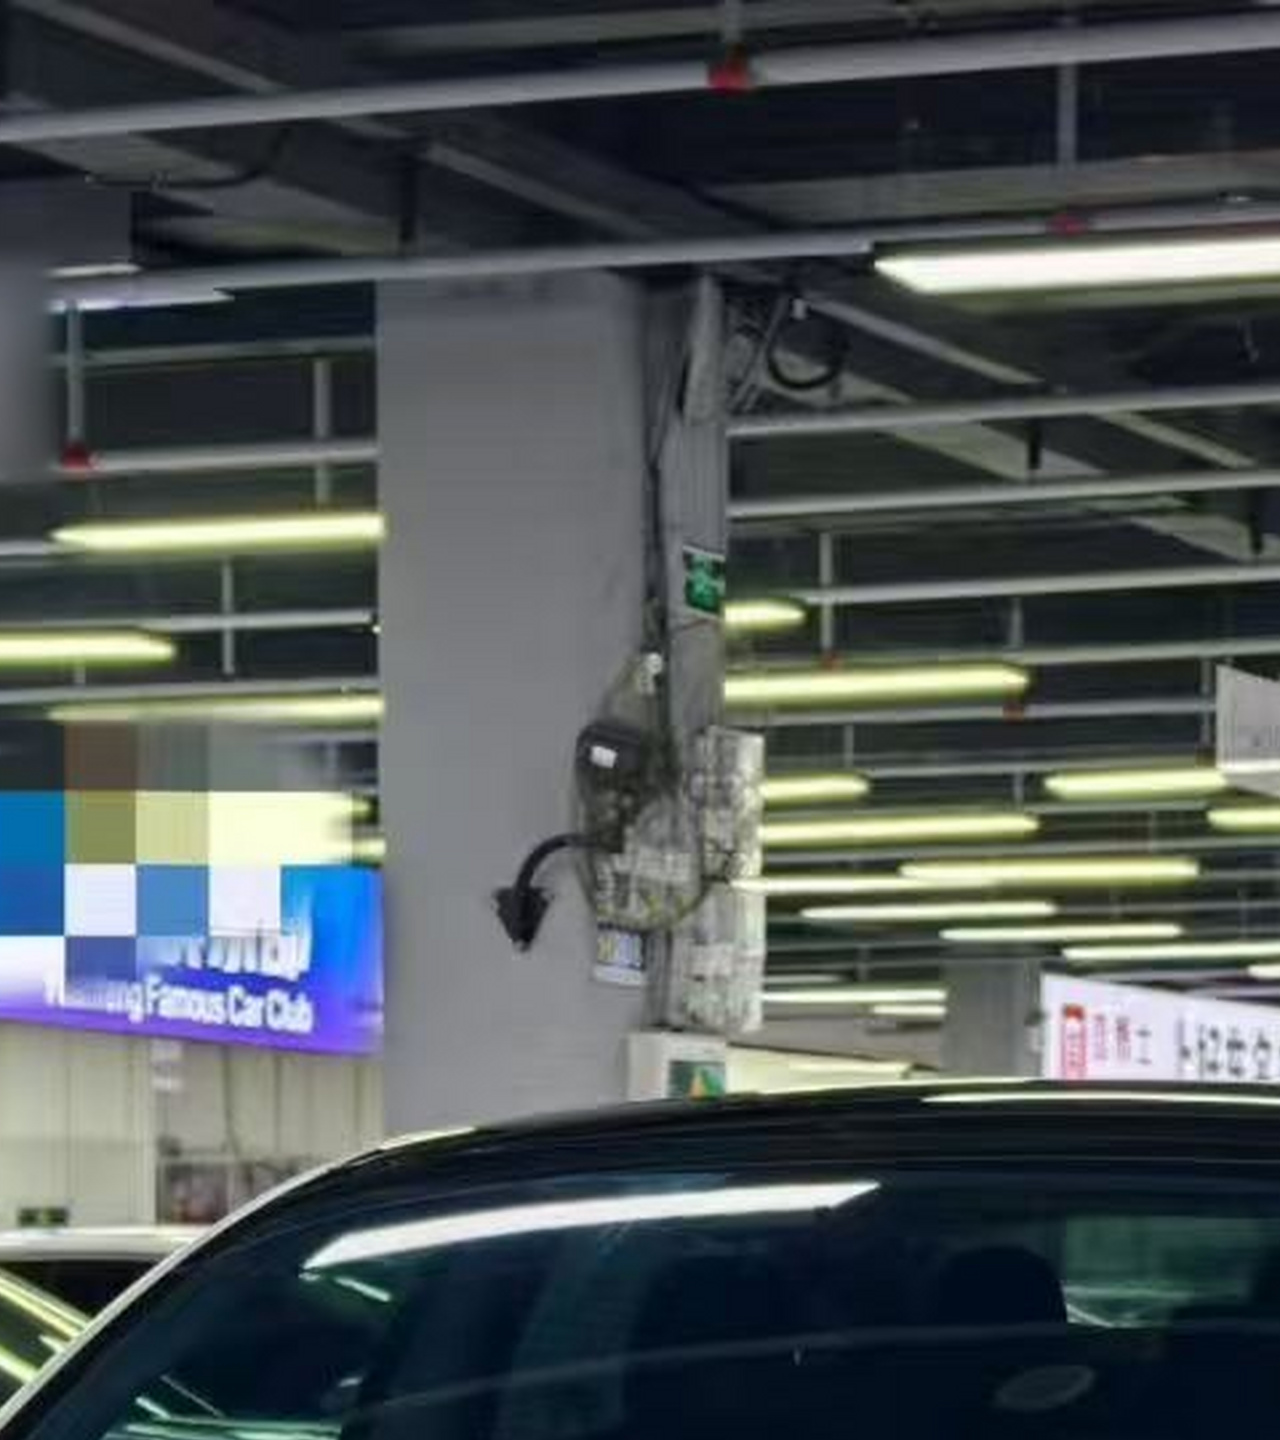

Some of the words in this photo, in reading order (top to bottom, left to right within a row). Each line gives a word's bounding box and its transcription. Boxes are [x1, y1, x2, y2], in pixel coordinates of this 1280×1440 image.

[145, 973, 226, 1024] Famous
[228, 984, 263, 1028] Car
[266, 988, 313, 1033] Club
